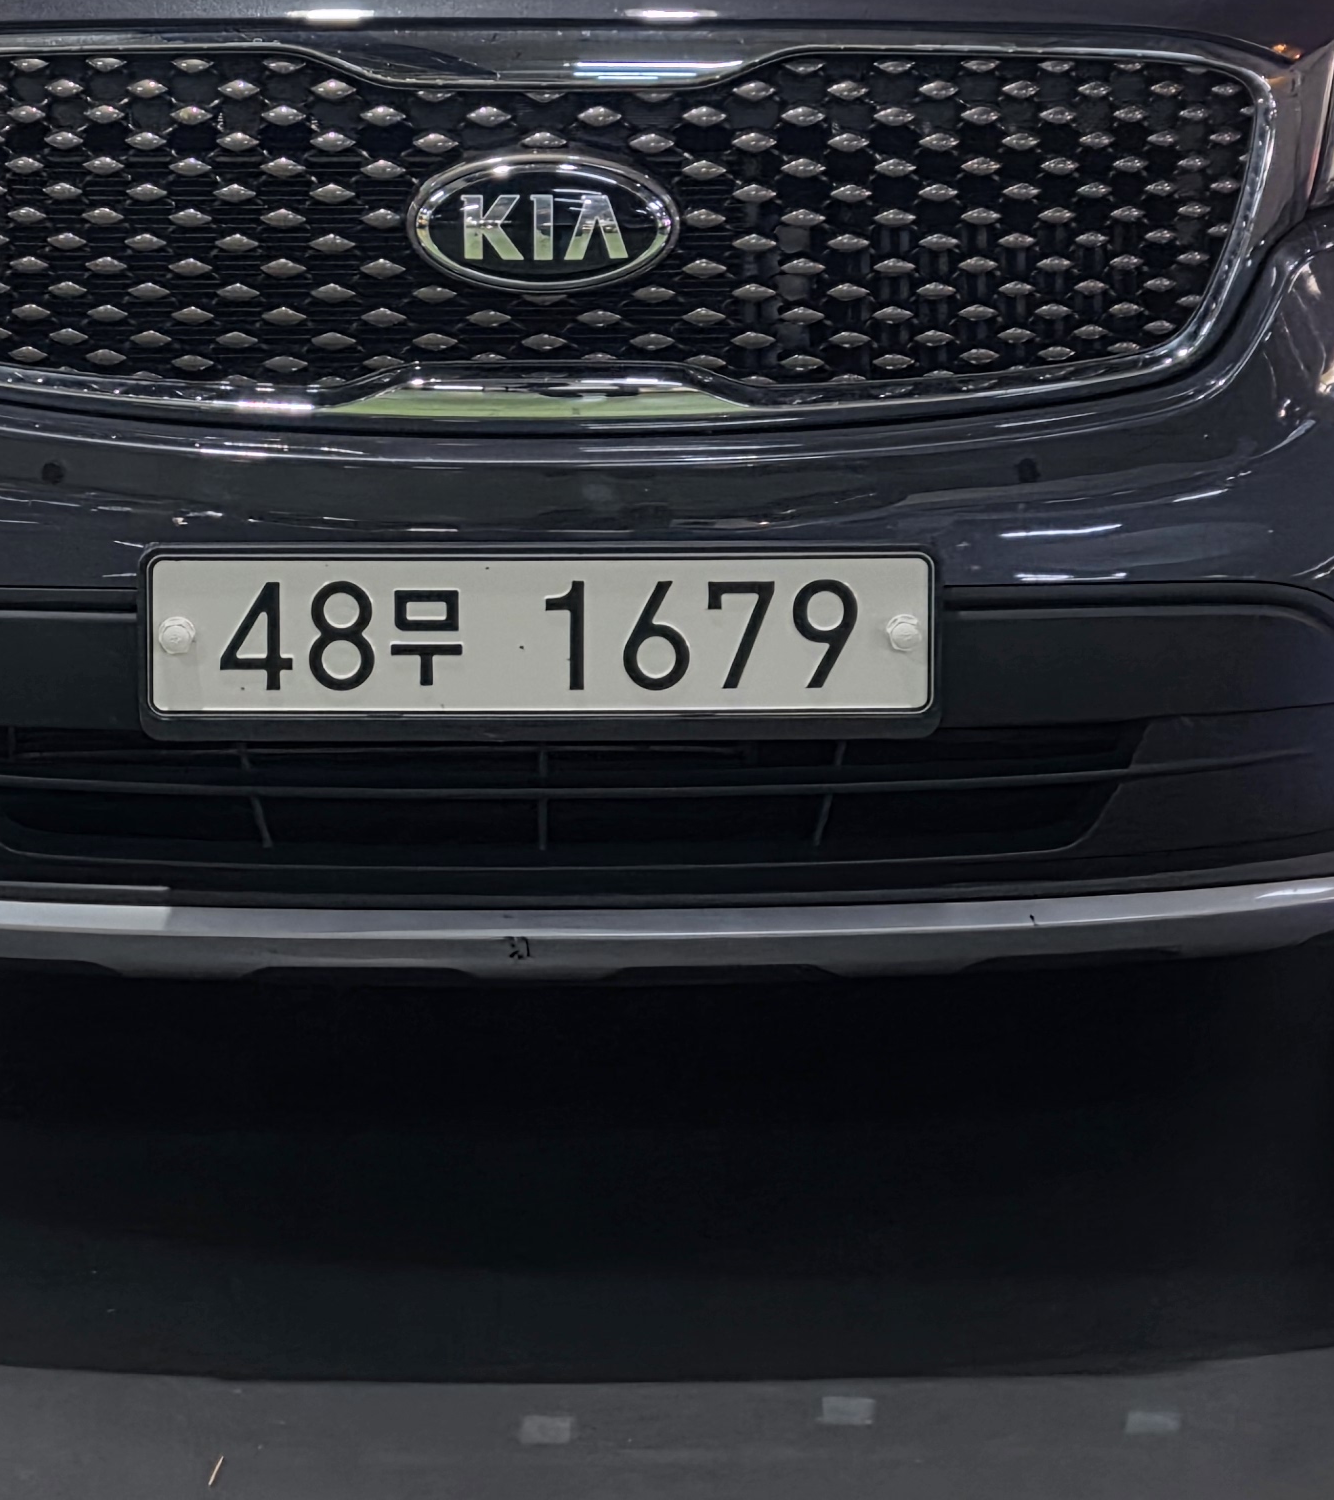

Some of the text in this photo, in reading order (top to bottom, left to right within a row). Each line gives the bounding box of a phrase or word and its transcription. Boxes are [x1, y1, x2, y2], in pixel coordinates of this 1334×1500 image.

[460, 193, 629, 261] KIA
[219, 579, 859, 691] 48무 1679
